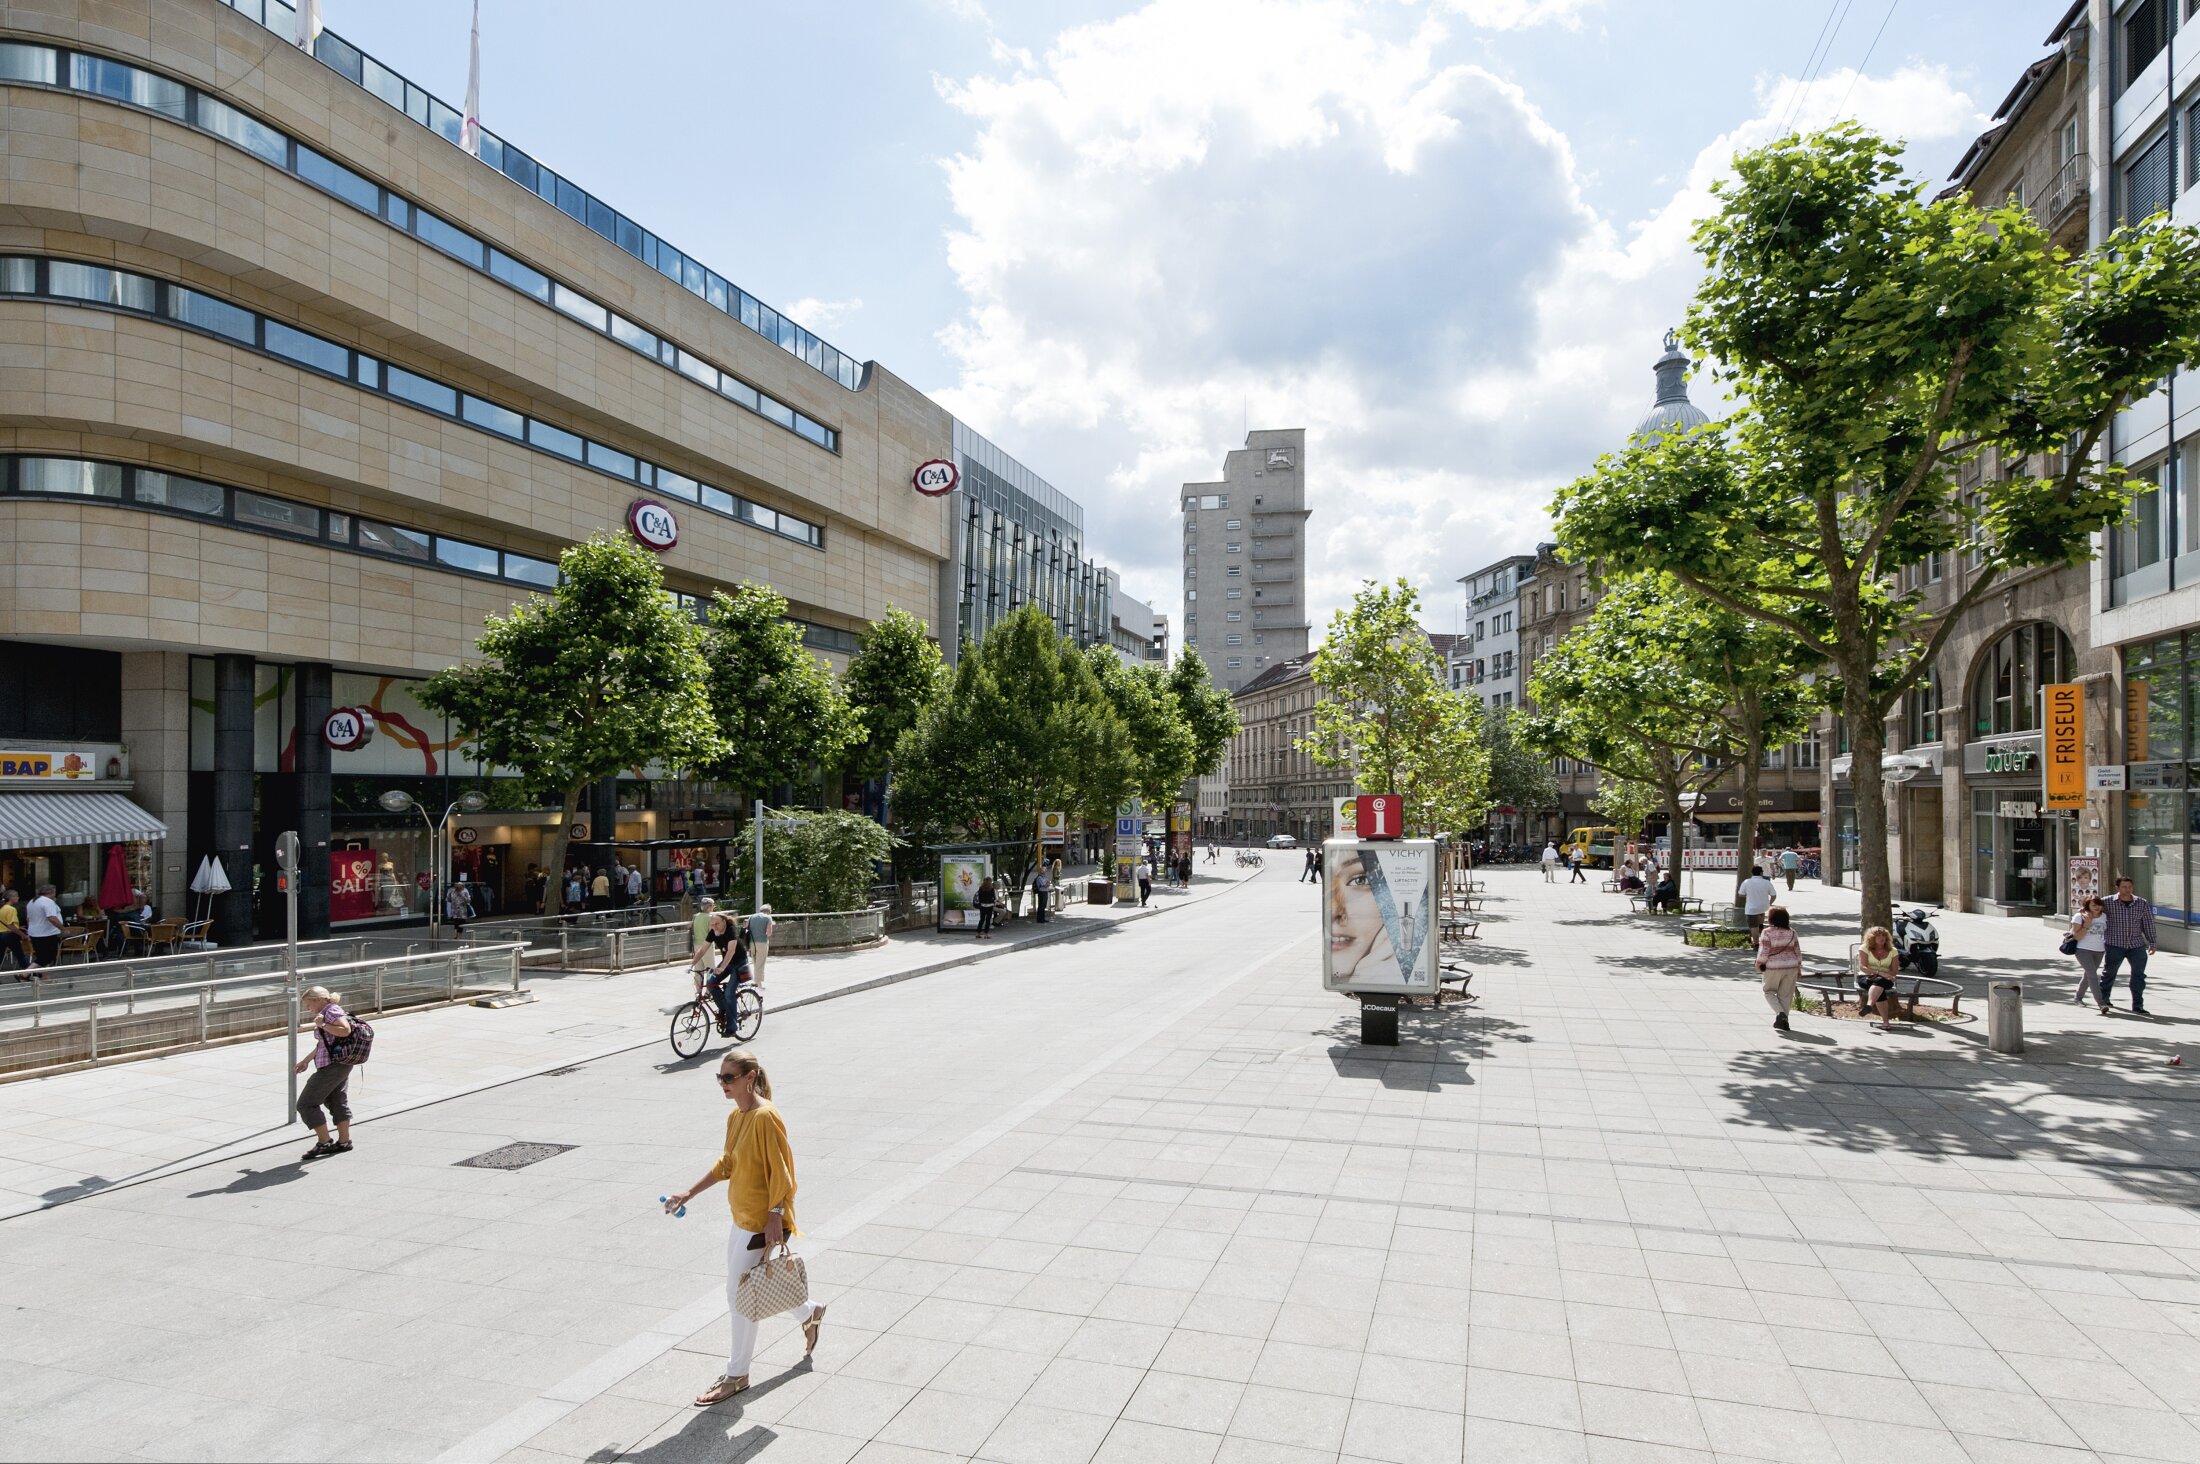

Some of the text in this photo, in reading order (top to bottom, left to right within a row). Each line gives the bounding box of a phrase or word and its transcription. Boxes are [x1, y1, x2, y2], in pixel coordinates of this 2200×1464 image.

[920, 468, 949, 485] C&A
[641, 511, 673, 539] C&A
[328, 718, 356, 738] C&A
[2055, 689, 2076, 764] FRISEUR
[0, 760, 49, 776] BAP
[2049, 792, 2084, 801] bauer
[1121, 820, 1131, 832] U
[1389, 849, 1424, 858] VICHY
[341, 864, 346, 879] I
[332, 877, 374, 895] SALE
[1362, 1004, 1396, 1012] JCDecaux
